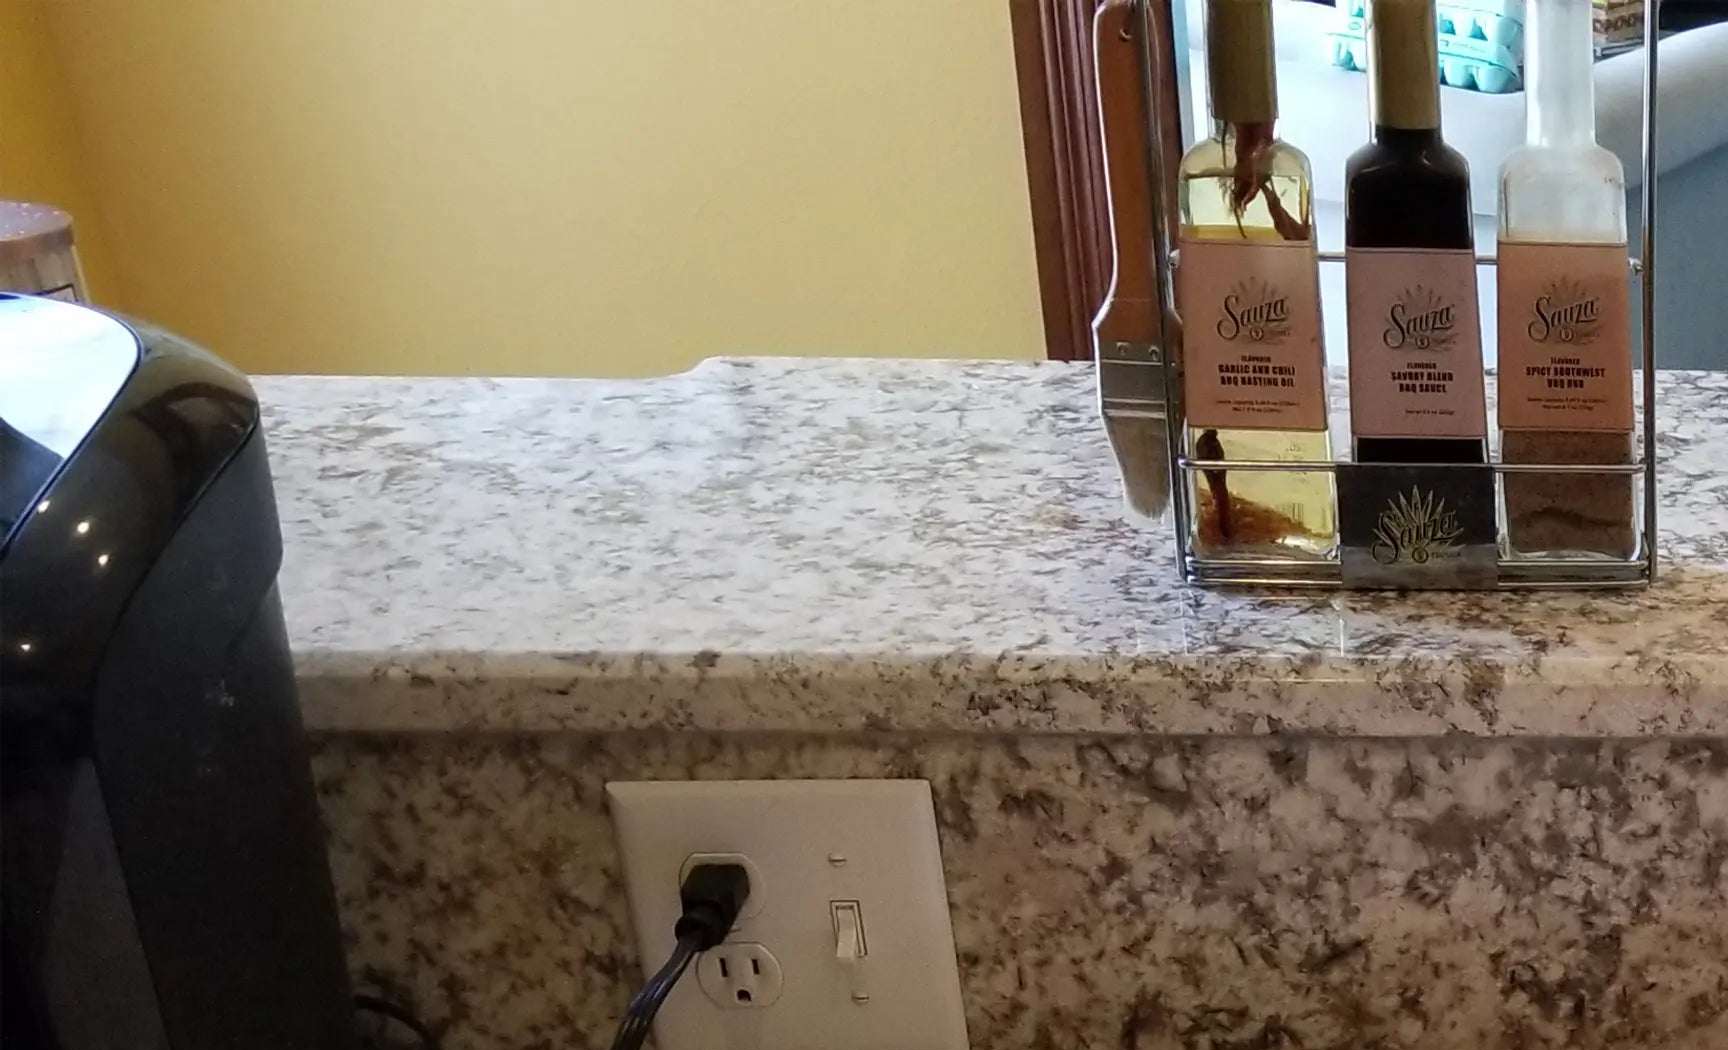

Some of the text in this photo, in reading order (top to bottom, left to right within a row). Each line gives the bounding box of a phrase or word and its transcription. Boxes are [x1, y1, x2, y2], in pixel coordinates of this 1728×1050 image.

[1216, 295, 1289, 341] Sauza
[1527, 296, 1599, 343] Sauza
[1383, 303, 1455, 350] Sauza
[1218, 364, 1295, 376] GARLIC AND CHILI
[1526, 366, 1606, 377] SPICY SOUTHWEST
[1220, 376, 1295, 388] BBQ BASTING OIL
[1391, 371, 1454, 382] SAVORY BLEND
[1399, 383, 1447, 394] BBQ SAUCE
[1547, 379, 1584, 389] BBQ RUB
[1372, 509, 1463, 565] Sauza
